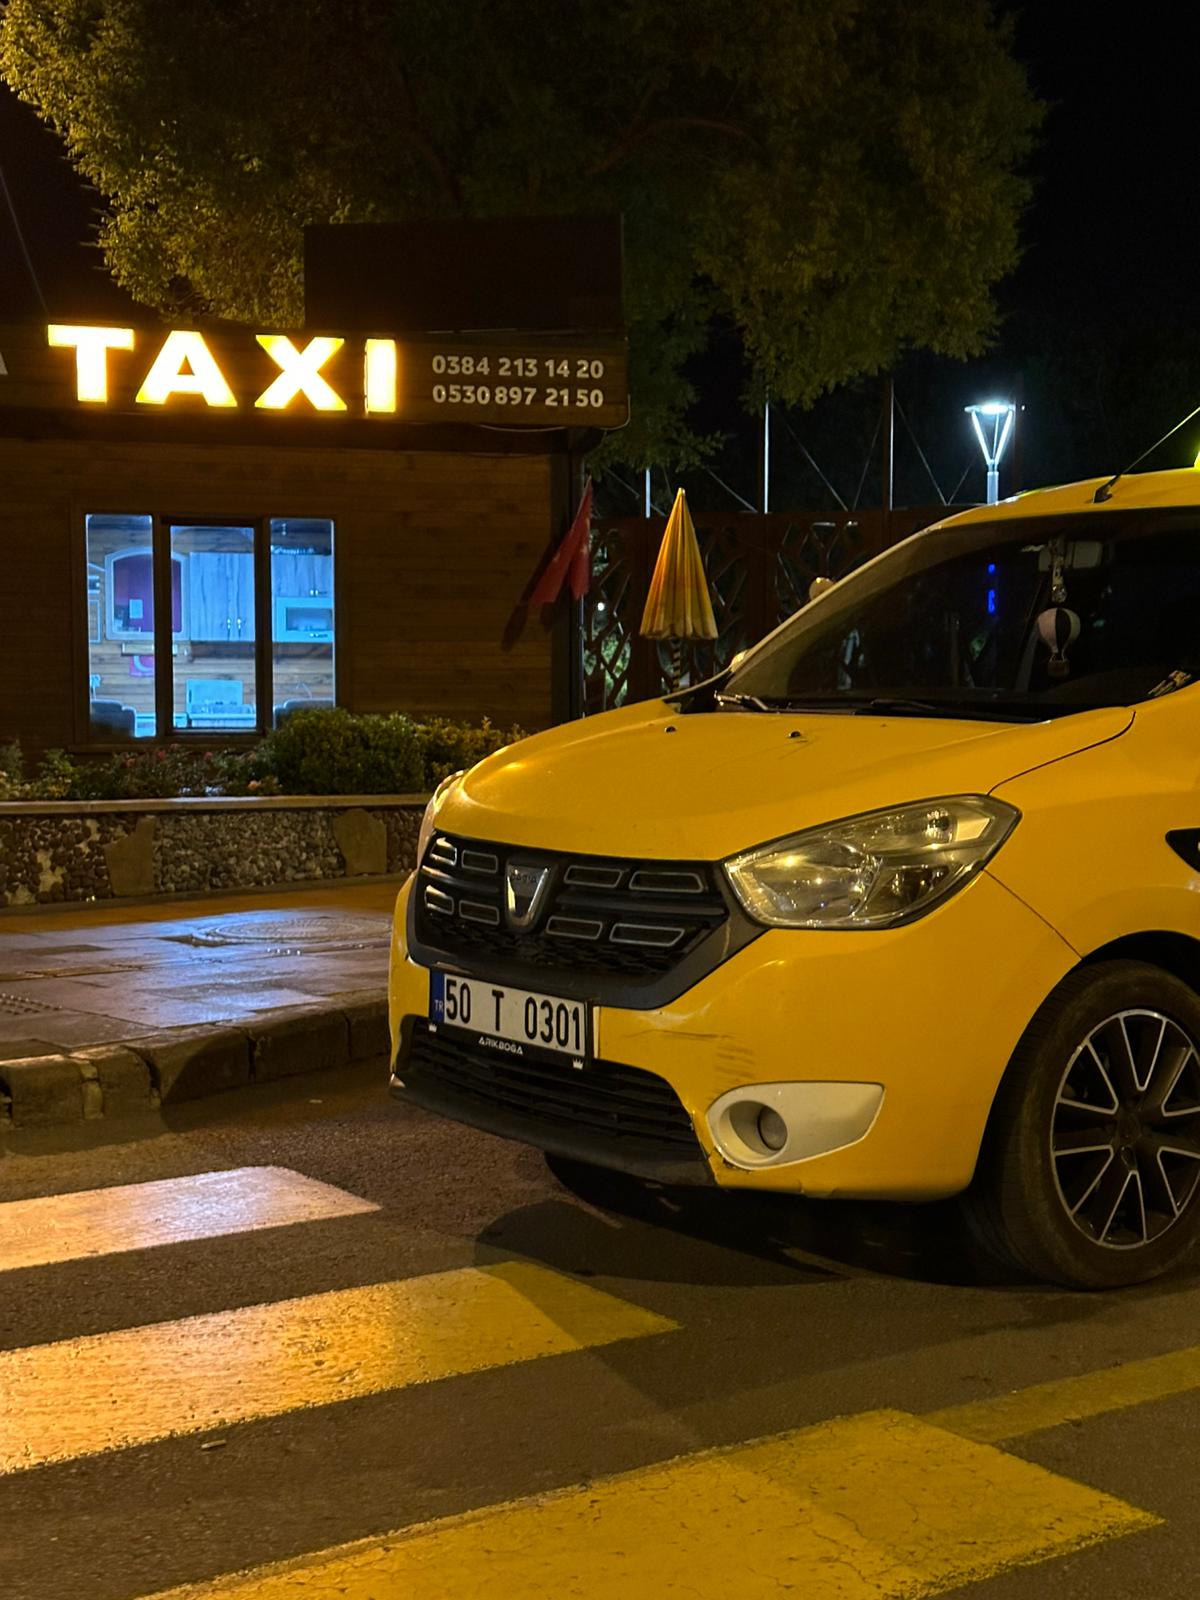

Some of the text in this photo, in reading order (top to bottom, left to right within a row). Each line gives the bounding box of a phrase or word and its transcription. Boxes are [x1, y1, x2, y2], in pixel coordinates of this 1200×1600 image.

[47, 324, 397, 413] TAXI
[432, 355, 604, 379] 0384 213 14 20
[432, 385, 604, 408] 0530 897 21 50
[446, 979, 580, 1050] 50 T 0301
